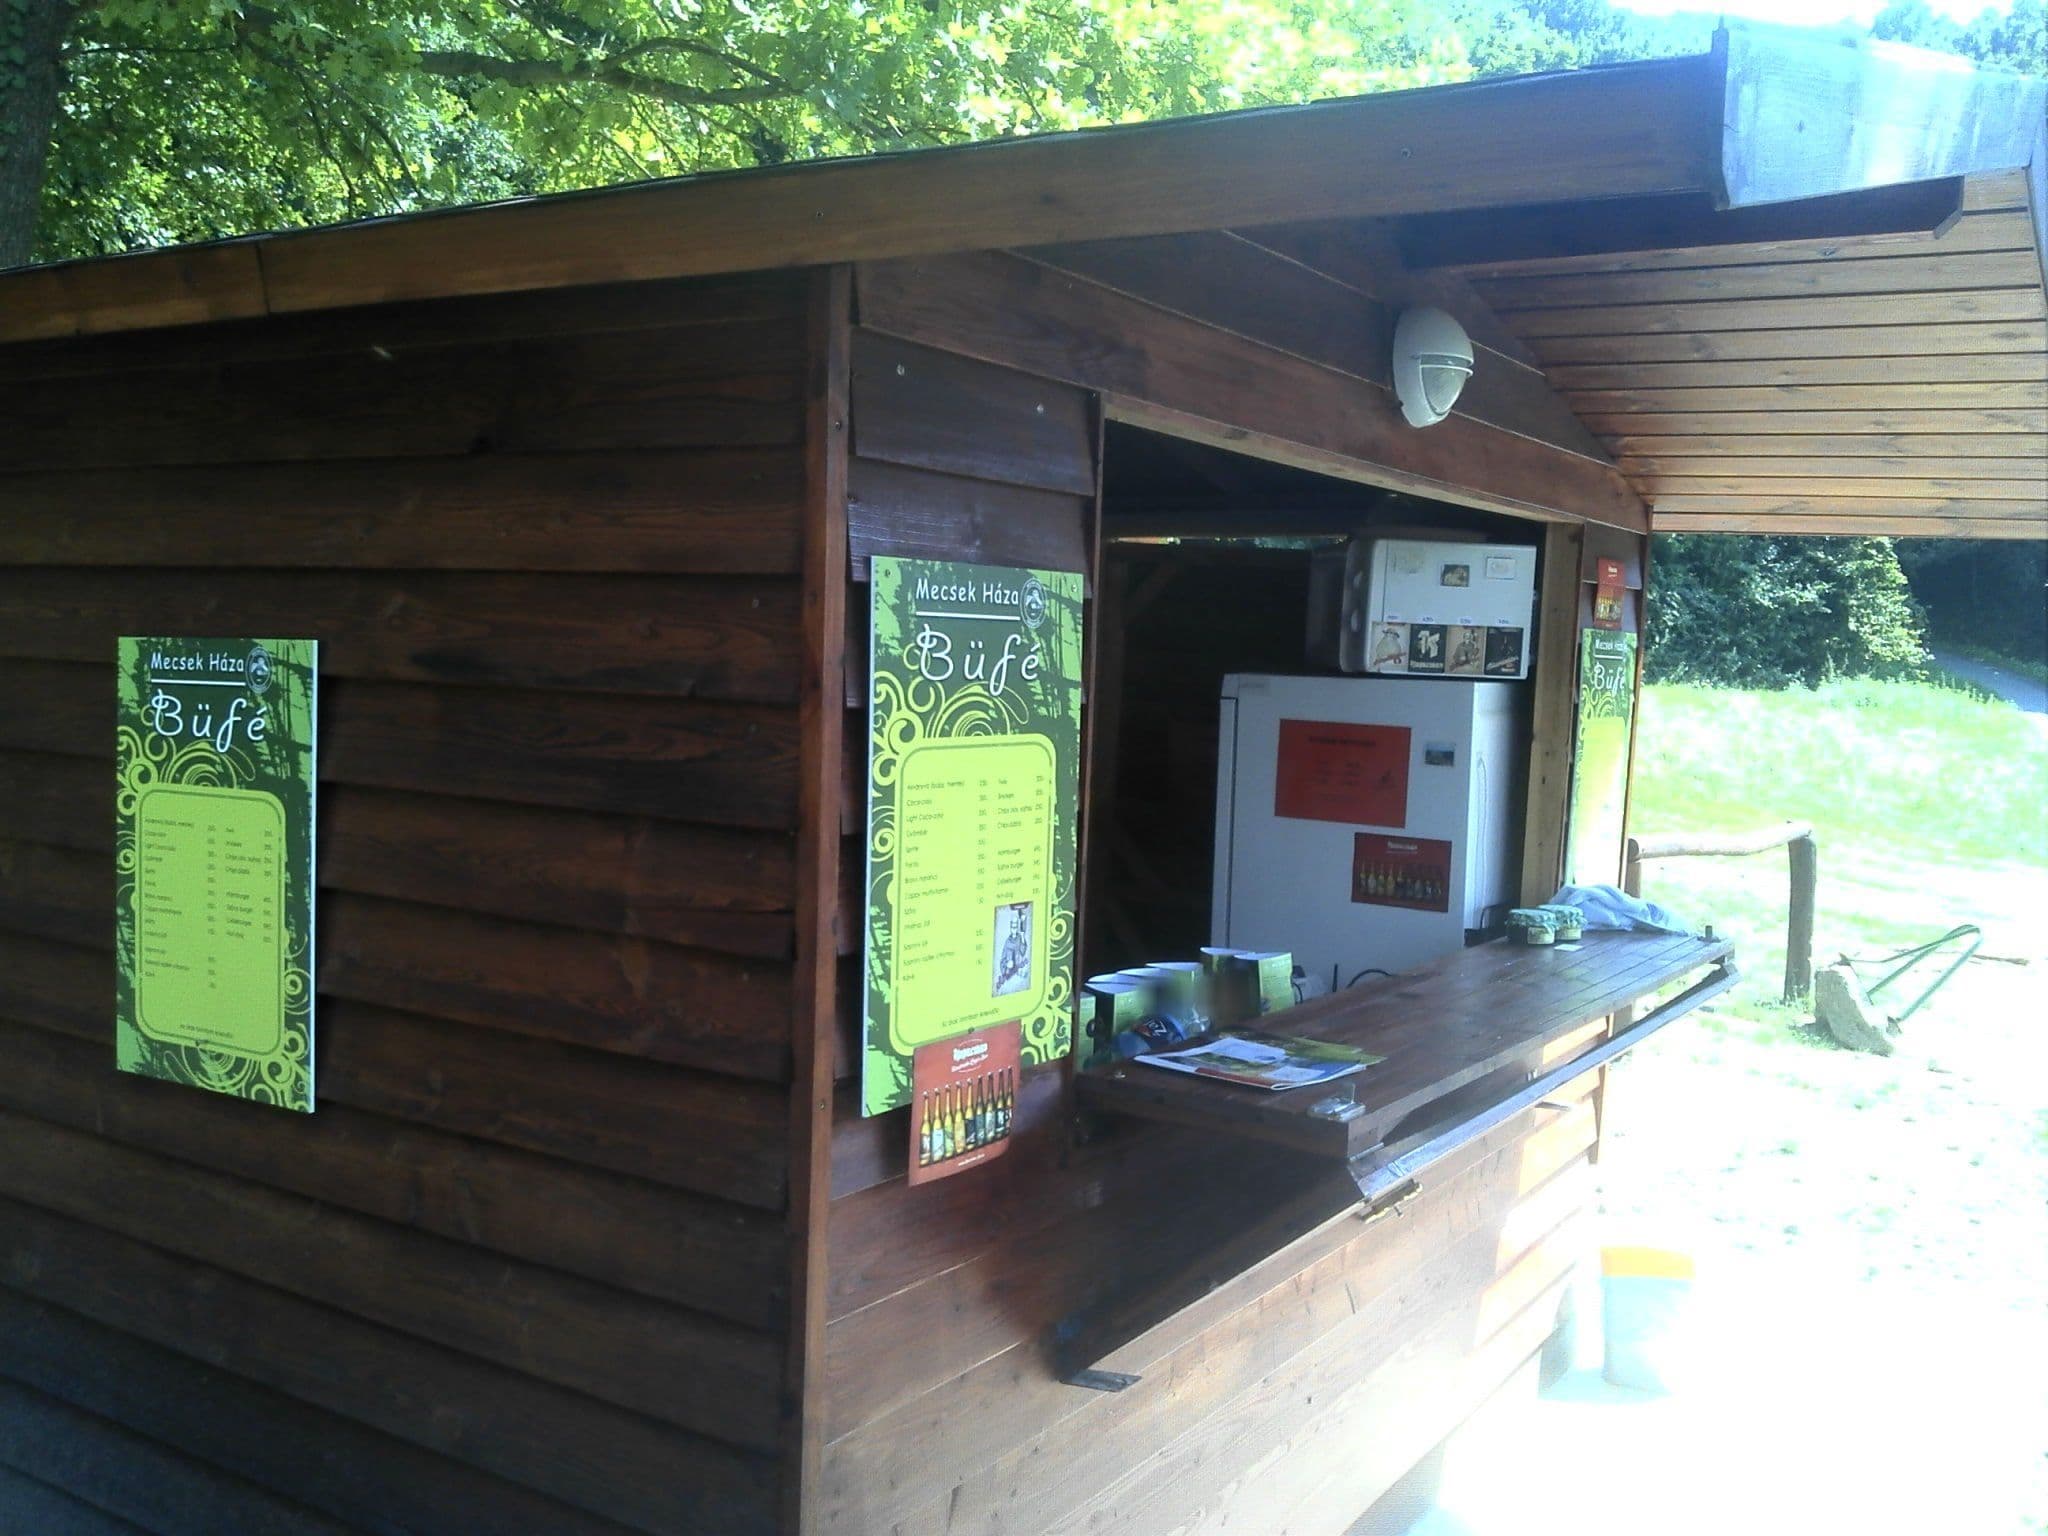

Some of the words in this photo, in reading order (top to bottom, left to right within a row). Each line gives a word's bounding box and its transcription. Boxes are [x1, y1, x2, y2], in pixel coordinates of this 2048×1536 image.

[916, 577, 977, 603] Mecsek
[982, 582, 1019, 607] Háza
[151, 651, 204, 672] Mecsek
[209, 651, 245, 673] Háza
[916, 623, 1041, 697] Büfé
[151, 688, 268, 754] Büfé
